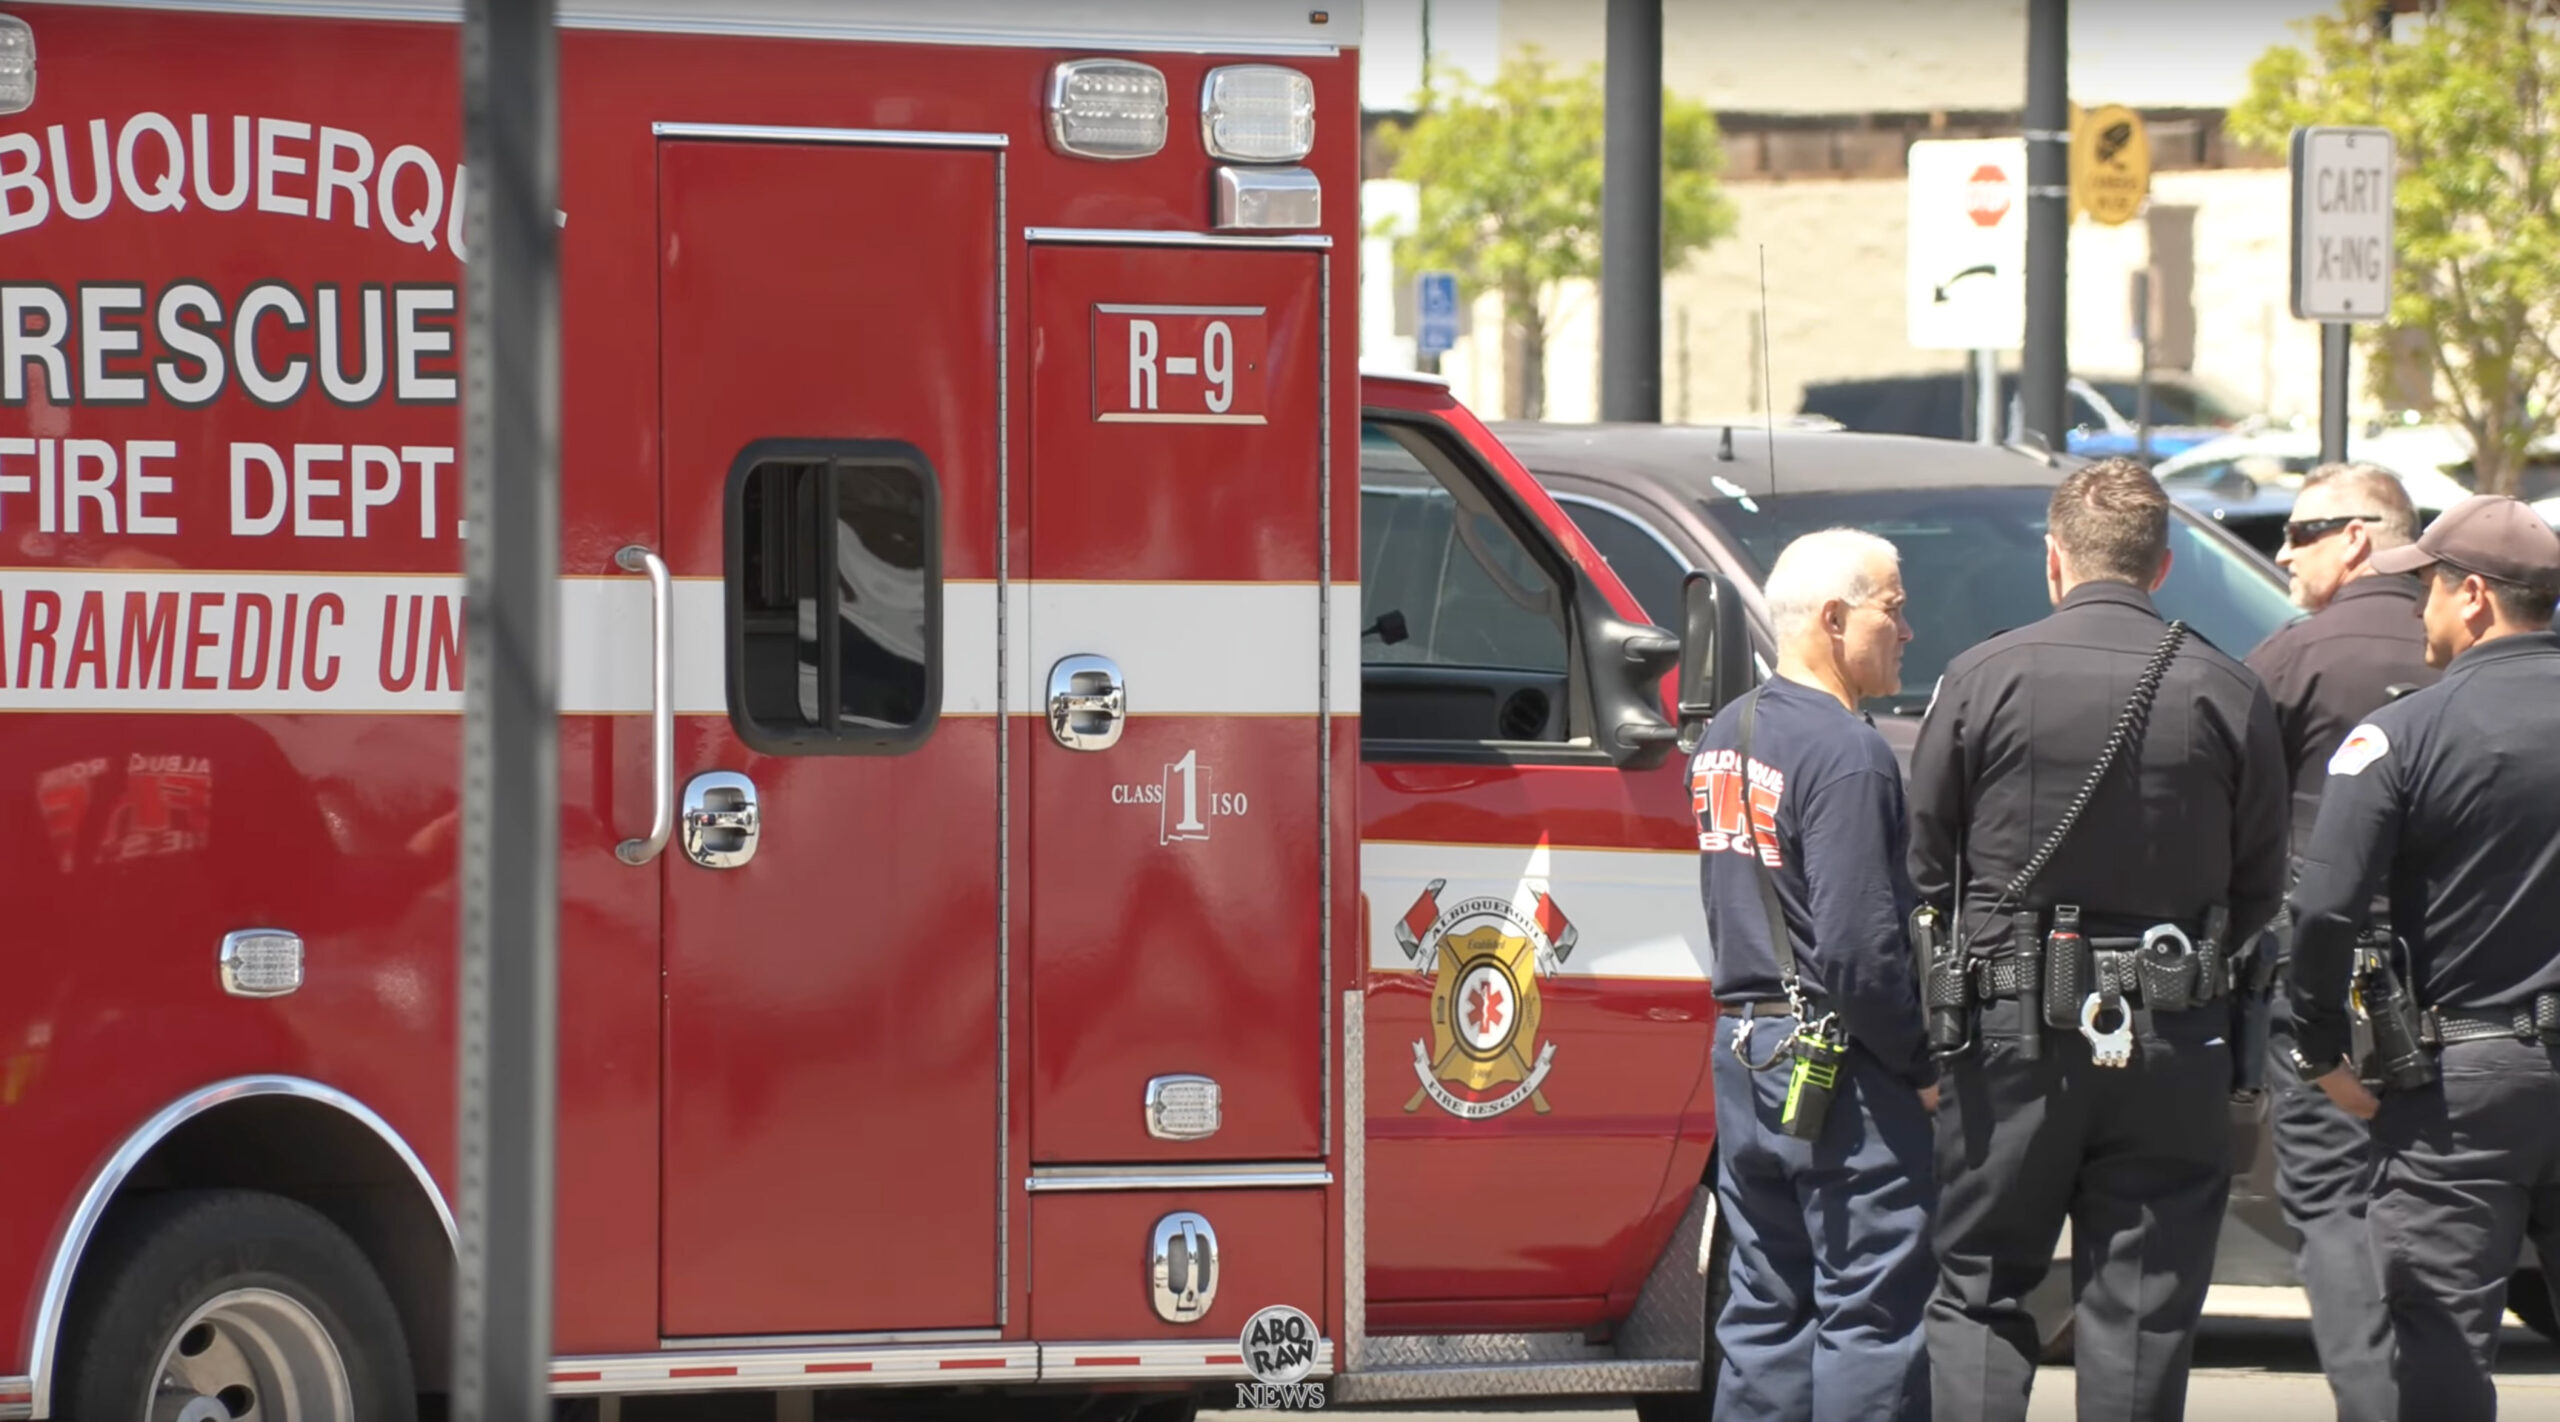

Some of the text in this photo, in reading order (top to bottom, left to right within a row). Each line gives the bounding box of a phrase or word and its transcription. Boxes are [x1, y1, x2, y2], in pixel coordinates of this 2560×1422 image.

[2317, 167, 2381, 214] CART
[2317, 235, 2380, 283] X-ING
[0, 282, 459, 404] RESCUE
[1129, 319, 1233, 413] R-9
[0, 438, 178, 535] FIRE
[0, 589, 345, 692] RAMEDIC
[1111, 749, 1248, 830] CLASS 1 ISO
[1427, 1080, 1532, 1115] FIRE RESCUE
